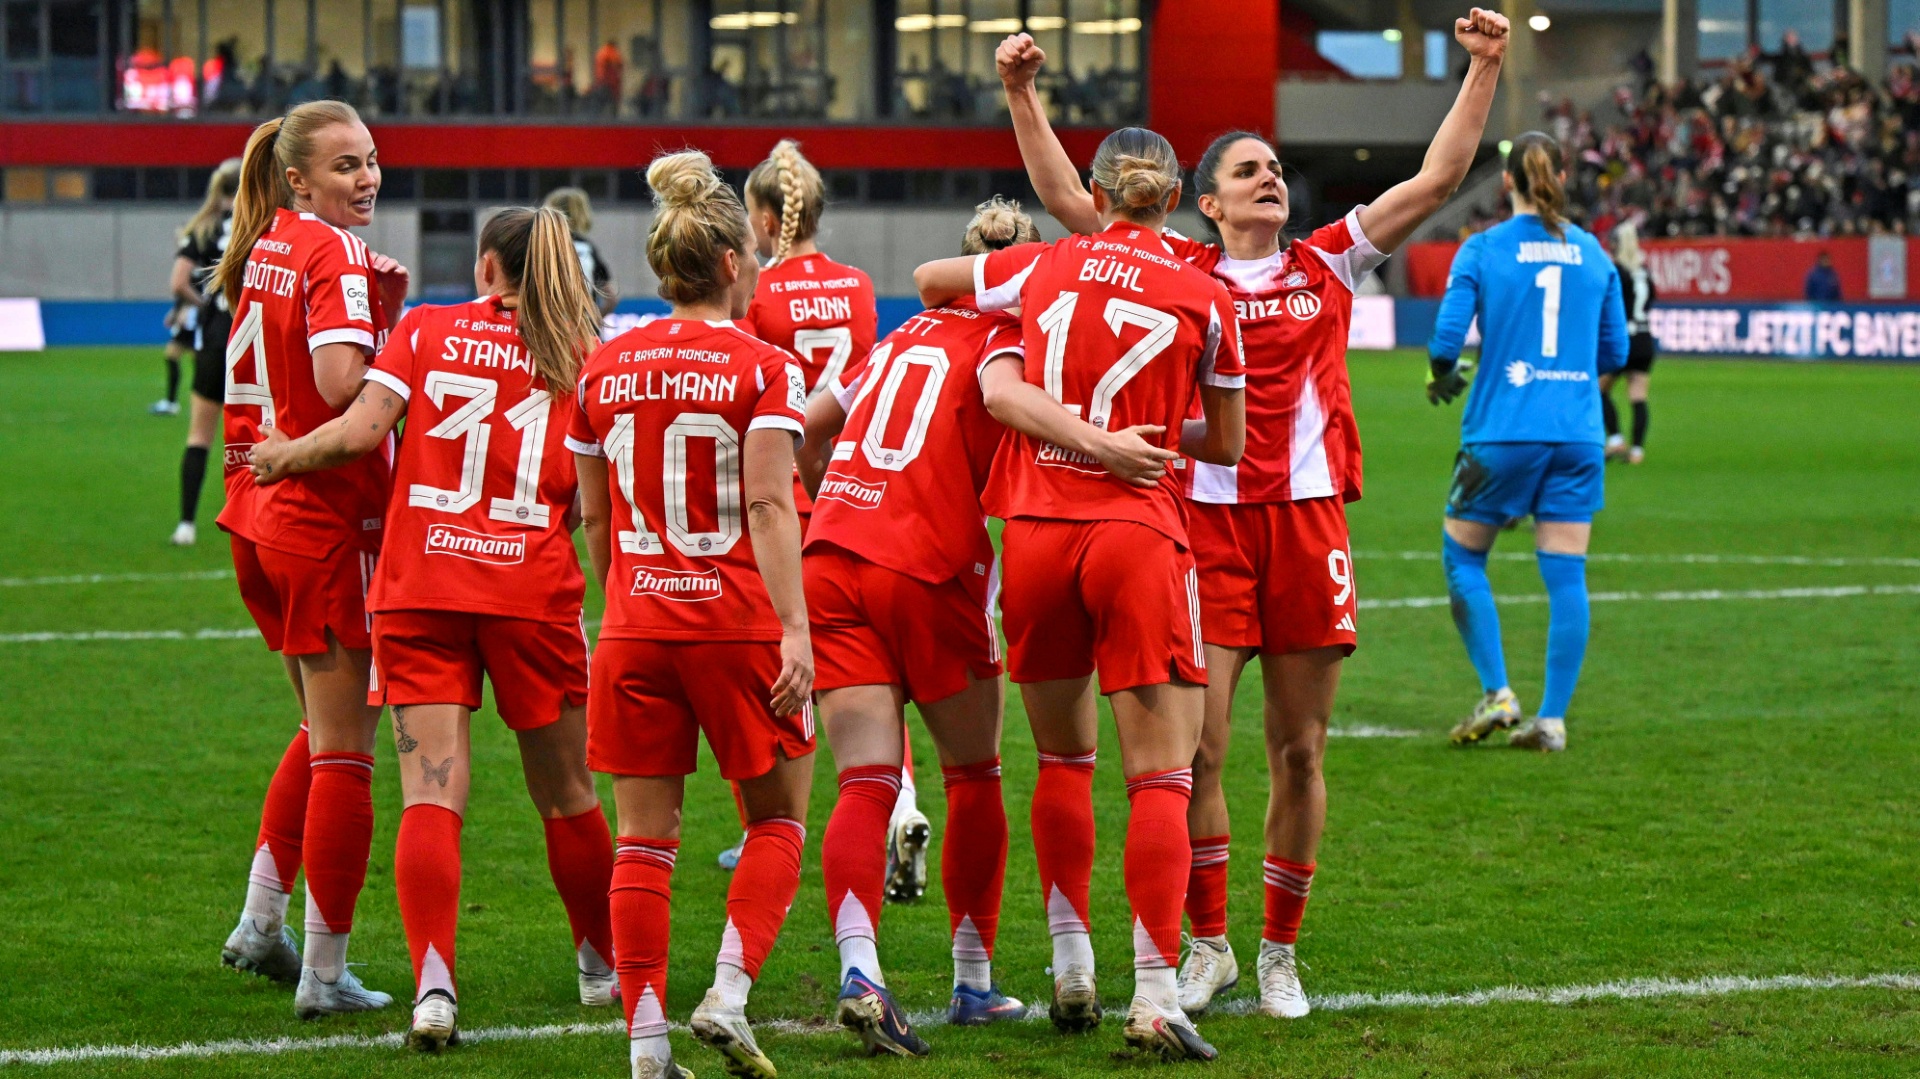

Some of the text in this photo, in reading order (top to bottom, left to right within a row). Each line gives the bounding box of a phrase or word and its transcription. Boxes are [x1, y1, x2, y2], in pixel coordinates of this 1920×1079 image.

[1076, 240, 1091, 249] FC
[1091, 240, 1131, 254] BAYERN
[770, 282, 783, 293] FC
[784, 280, 821, 291] BAYERN
[1078, 255, 1144, 293] BÜHL
[454, 319, 469, 329] FC
[471, 320, 512, 333] BAYERN
[789, 295, 852, 322] GWINN
[1535, 265, 1562, 358] 1
[618, 351, 632, 363] FC
[634, 347, 674, 362] BAYERN
[1816, 311, 1851, 355] FC
[1853, 312, 1920, 357] BAYE
[225, 301, 277, 428] 4
[794, 327, 853, 402] 7
[1036, 290, 1180, 432] 17
[599, 370, 738, 404] DALLMANN
[829, 341, 950, 472] 20
[408, 370, 551, 528] 31
[603, 412, 742, 557] 10
[429, 528, 523, 557] Ehrmann
[635, 570, 719, 592] Ehrmann
[1328, 549, 1351, 606] 9
